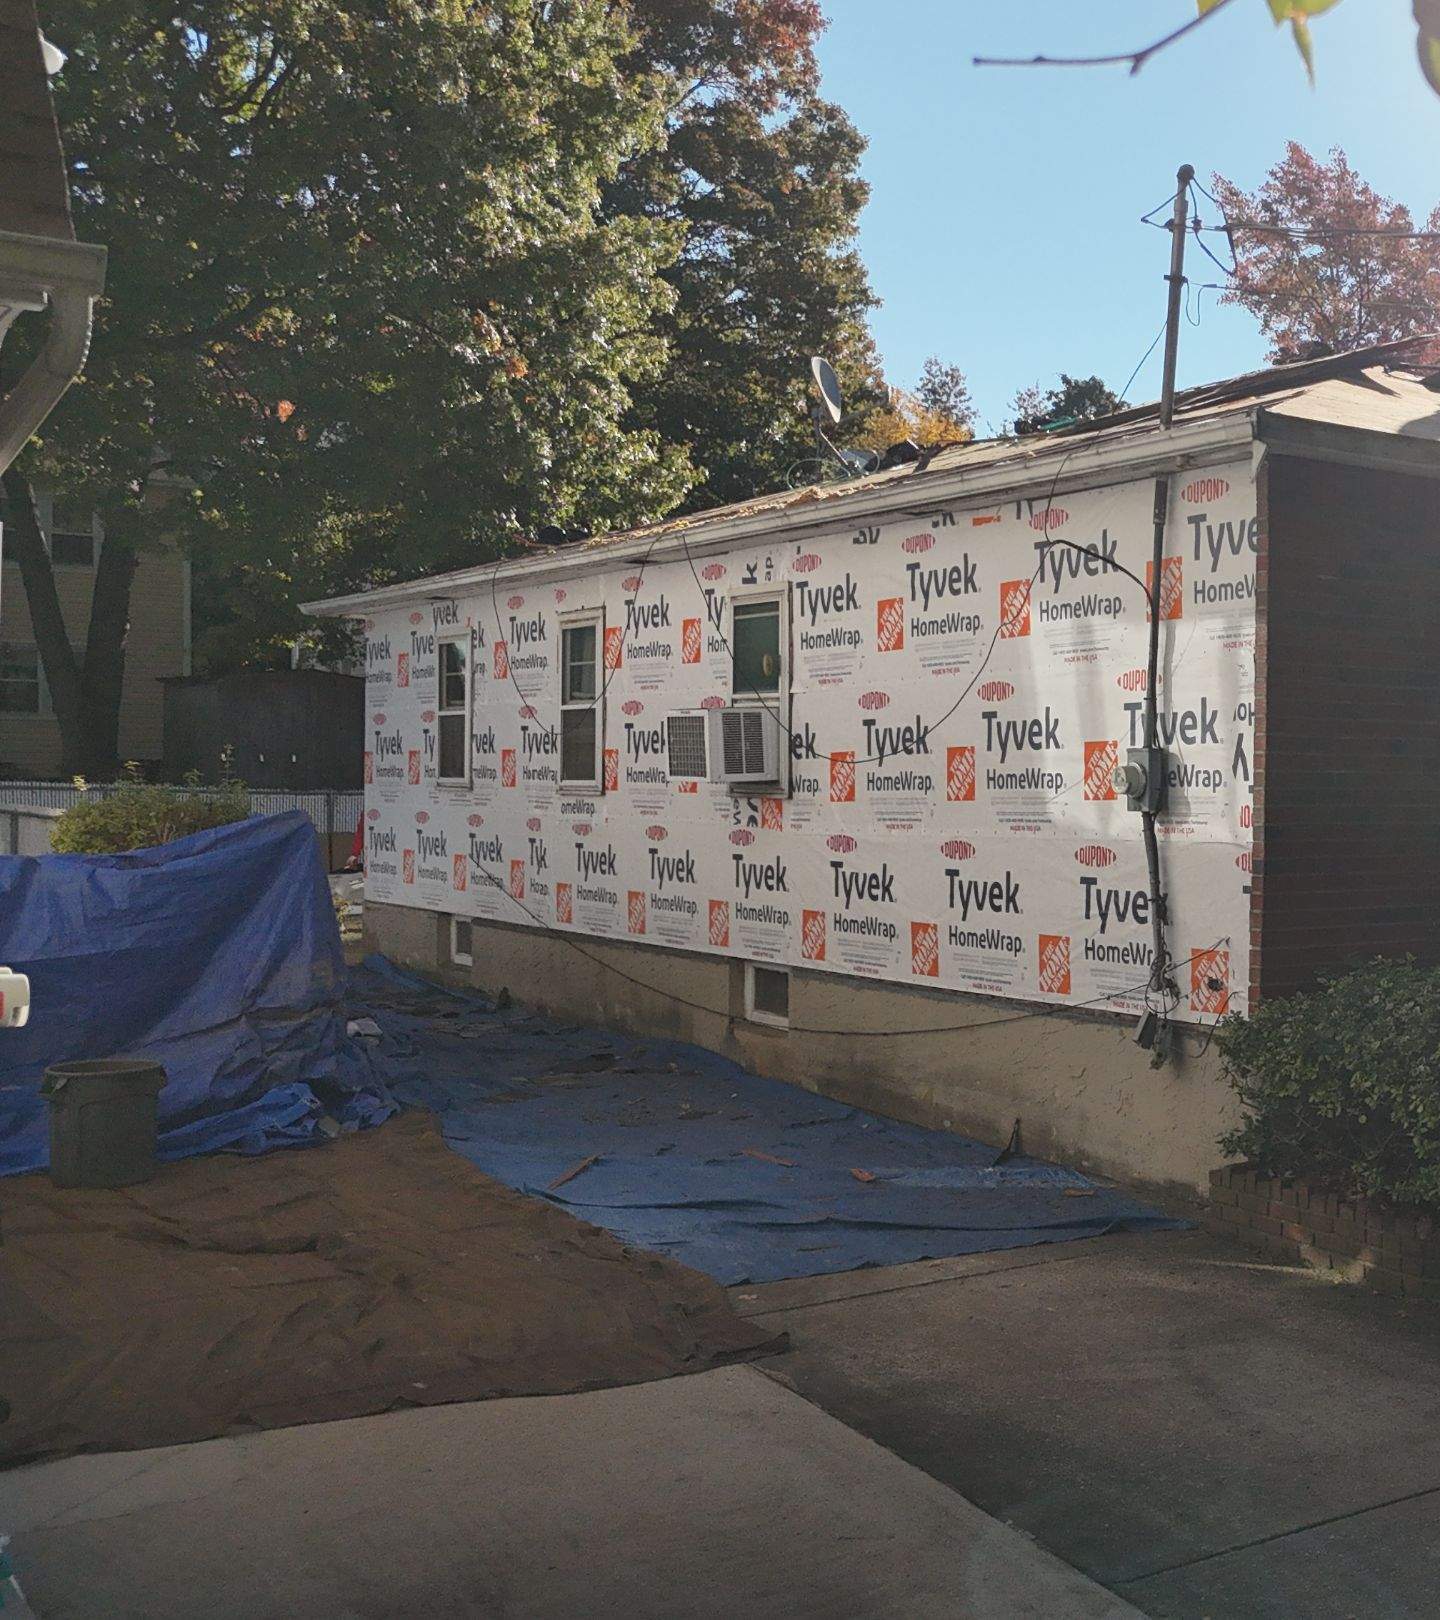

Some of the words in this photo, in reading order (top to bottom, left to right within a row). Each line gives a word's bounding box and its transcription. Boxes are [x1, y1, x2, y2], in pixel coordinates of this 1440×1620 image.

[1187, 478, 1224, 503] DUPONT
[1034, 529, 1118, 594] Tyvek
[906, 553, 977, 611] Tyvek
[796, 573, 858, 626] Tyvek
[1039, 593, 1122, 622] HomeWrap
[509, 612, 547, 652] Tyvek
[625, 594, 670, 639] Tyvek
[911, 612, 981, 637] HomeWrap
[366, 634, 391, 668] yvek
[627, 642, 672, 661] HomeWrap
[800, 627, 861, 651] HomeWrap
[510, 653, 548, 671] HomeWrap
[982, 681, 1011, 702] DUPONT
[375, 730, 403, 762] Tyvek
[521, 725, 558, 762] Tyvek
[863, 715, 929, 768] Tyvek
[982, 707, 1061, 764] Tyvek
[1084, 738, 1117, 800] HOME
[1089, 749, 1102, 770] THE
[626, 767, 668, 787] HomeWra
[867, 771, 931, 797] HomeWrap
[987, 768, 1063, 793] HomeWrap
[1164, 764, 1222, 793] eWrap
[369, 825, 397, 857] Tyvek
[417, 829, 447, 862] Tyvek
[469, 832, 503, 868] Tyvek
[944, 840, 973, 861] DUPONT
[1079, 845, 1113, 867] DUPONT
[575, 843, 617, 882] Tyvek
[649, 847, 696, 890] Tyvek
[732, 853, 788, 899] Tyvek
[577, 885, 617, 906] HomeWrap
[830, 860, 895, 909] Tyvek
[945, 869, 1019, 921] Tyvek
[651, 894, 698, 919] HomeWrap
[735, 902, 790, 926] HomeWrap
[834, 913, 896, 942] HomeWrap
[949, 926, 1022, 957] HomeWrap
[1040, 936, 1070, 992] HOME
[1042, 941, 1055, 962] THE
